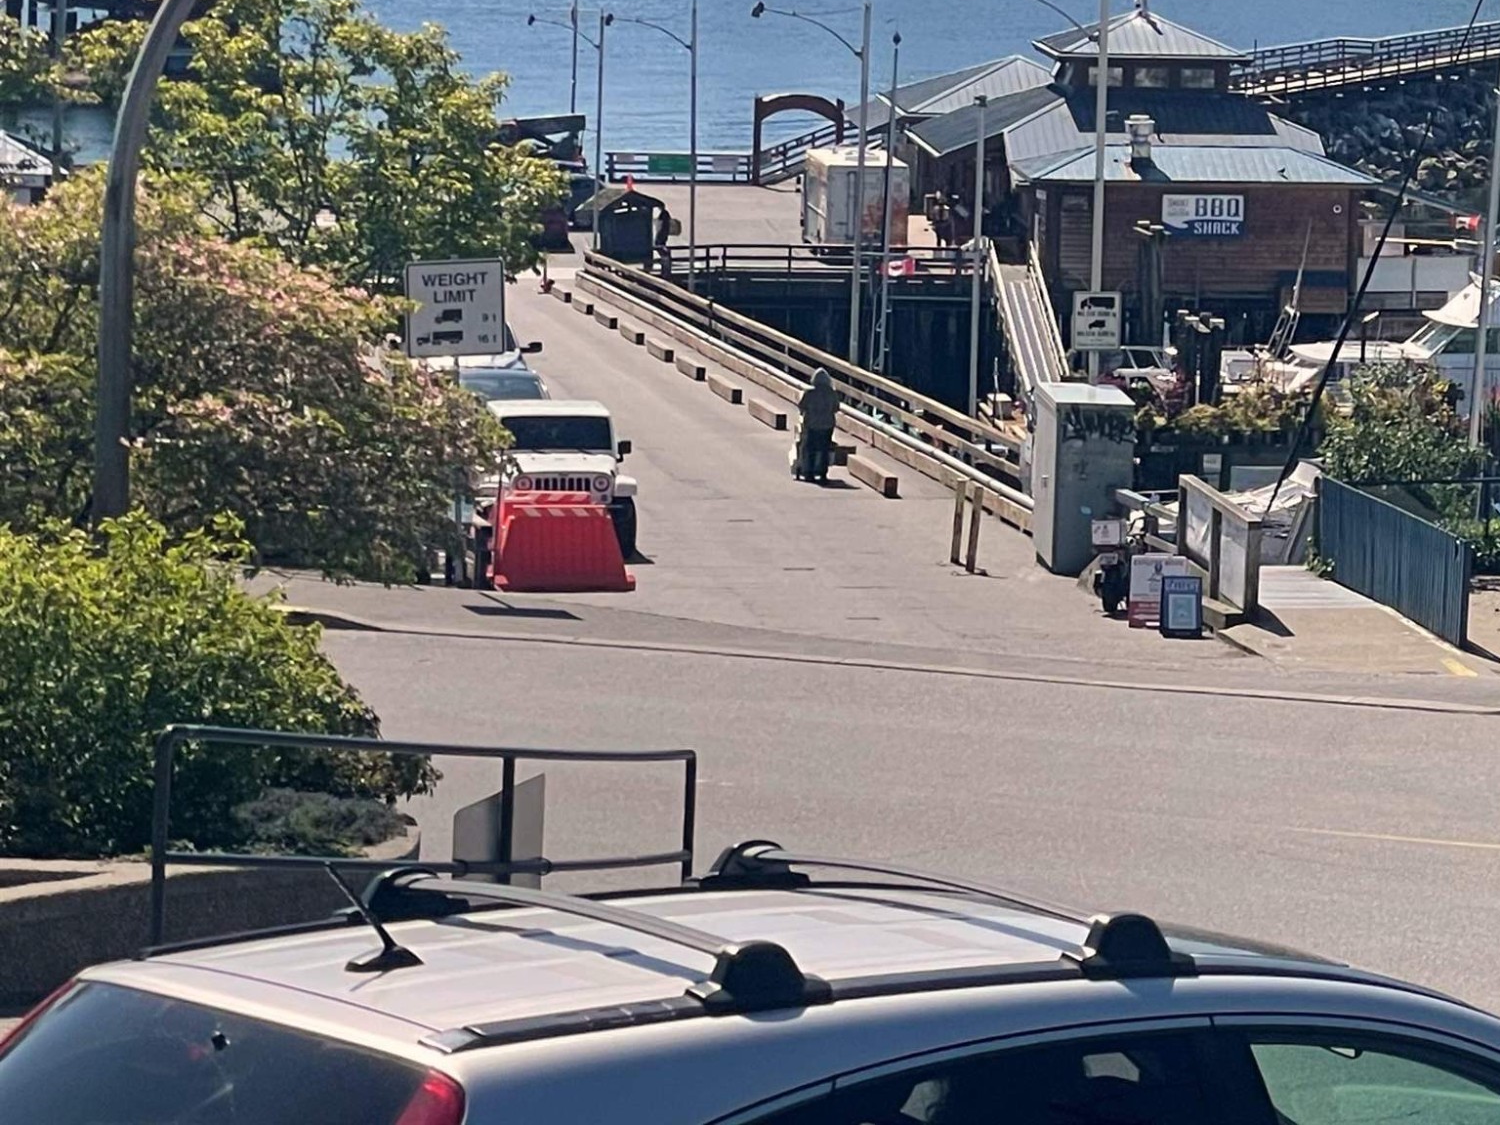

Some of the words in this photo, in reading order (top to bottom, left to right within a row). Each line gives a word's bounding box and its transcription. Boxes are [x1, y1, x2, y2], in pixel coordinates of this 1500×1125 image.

[1195, 197, 1241, 217] BBQ
[1193, 221, 1240, 235] SHACK
[421, 271, 488, 287] WEIGHT
[433, 288, 476, 303] LIMIT
